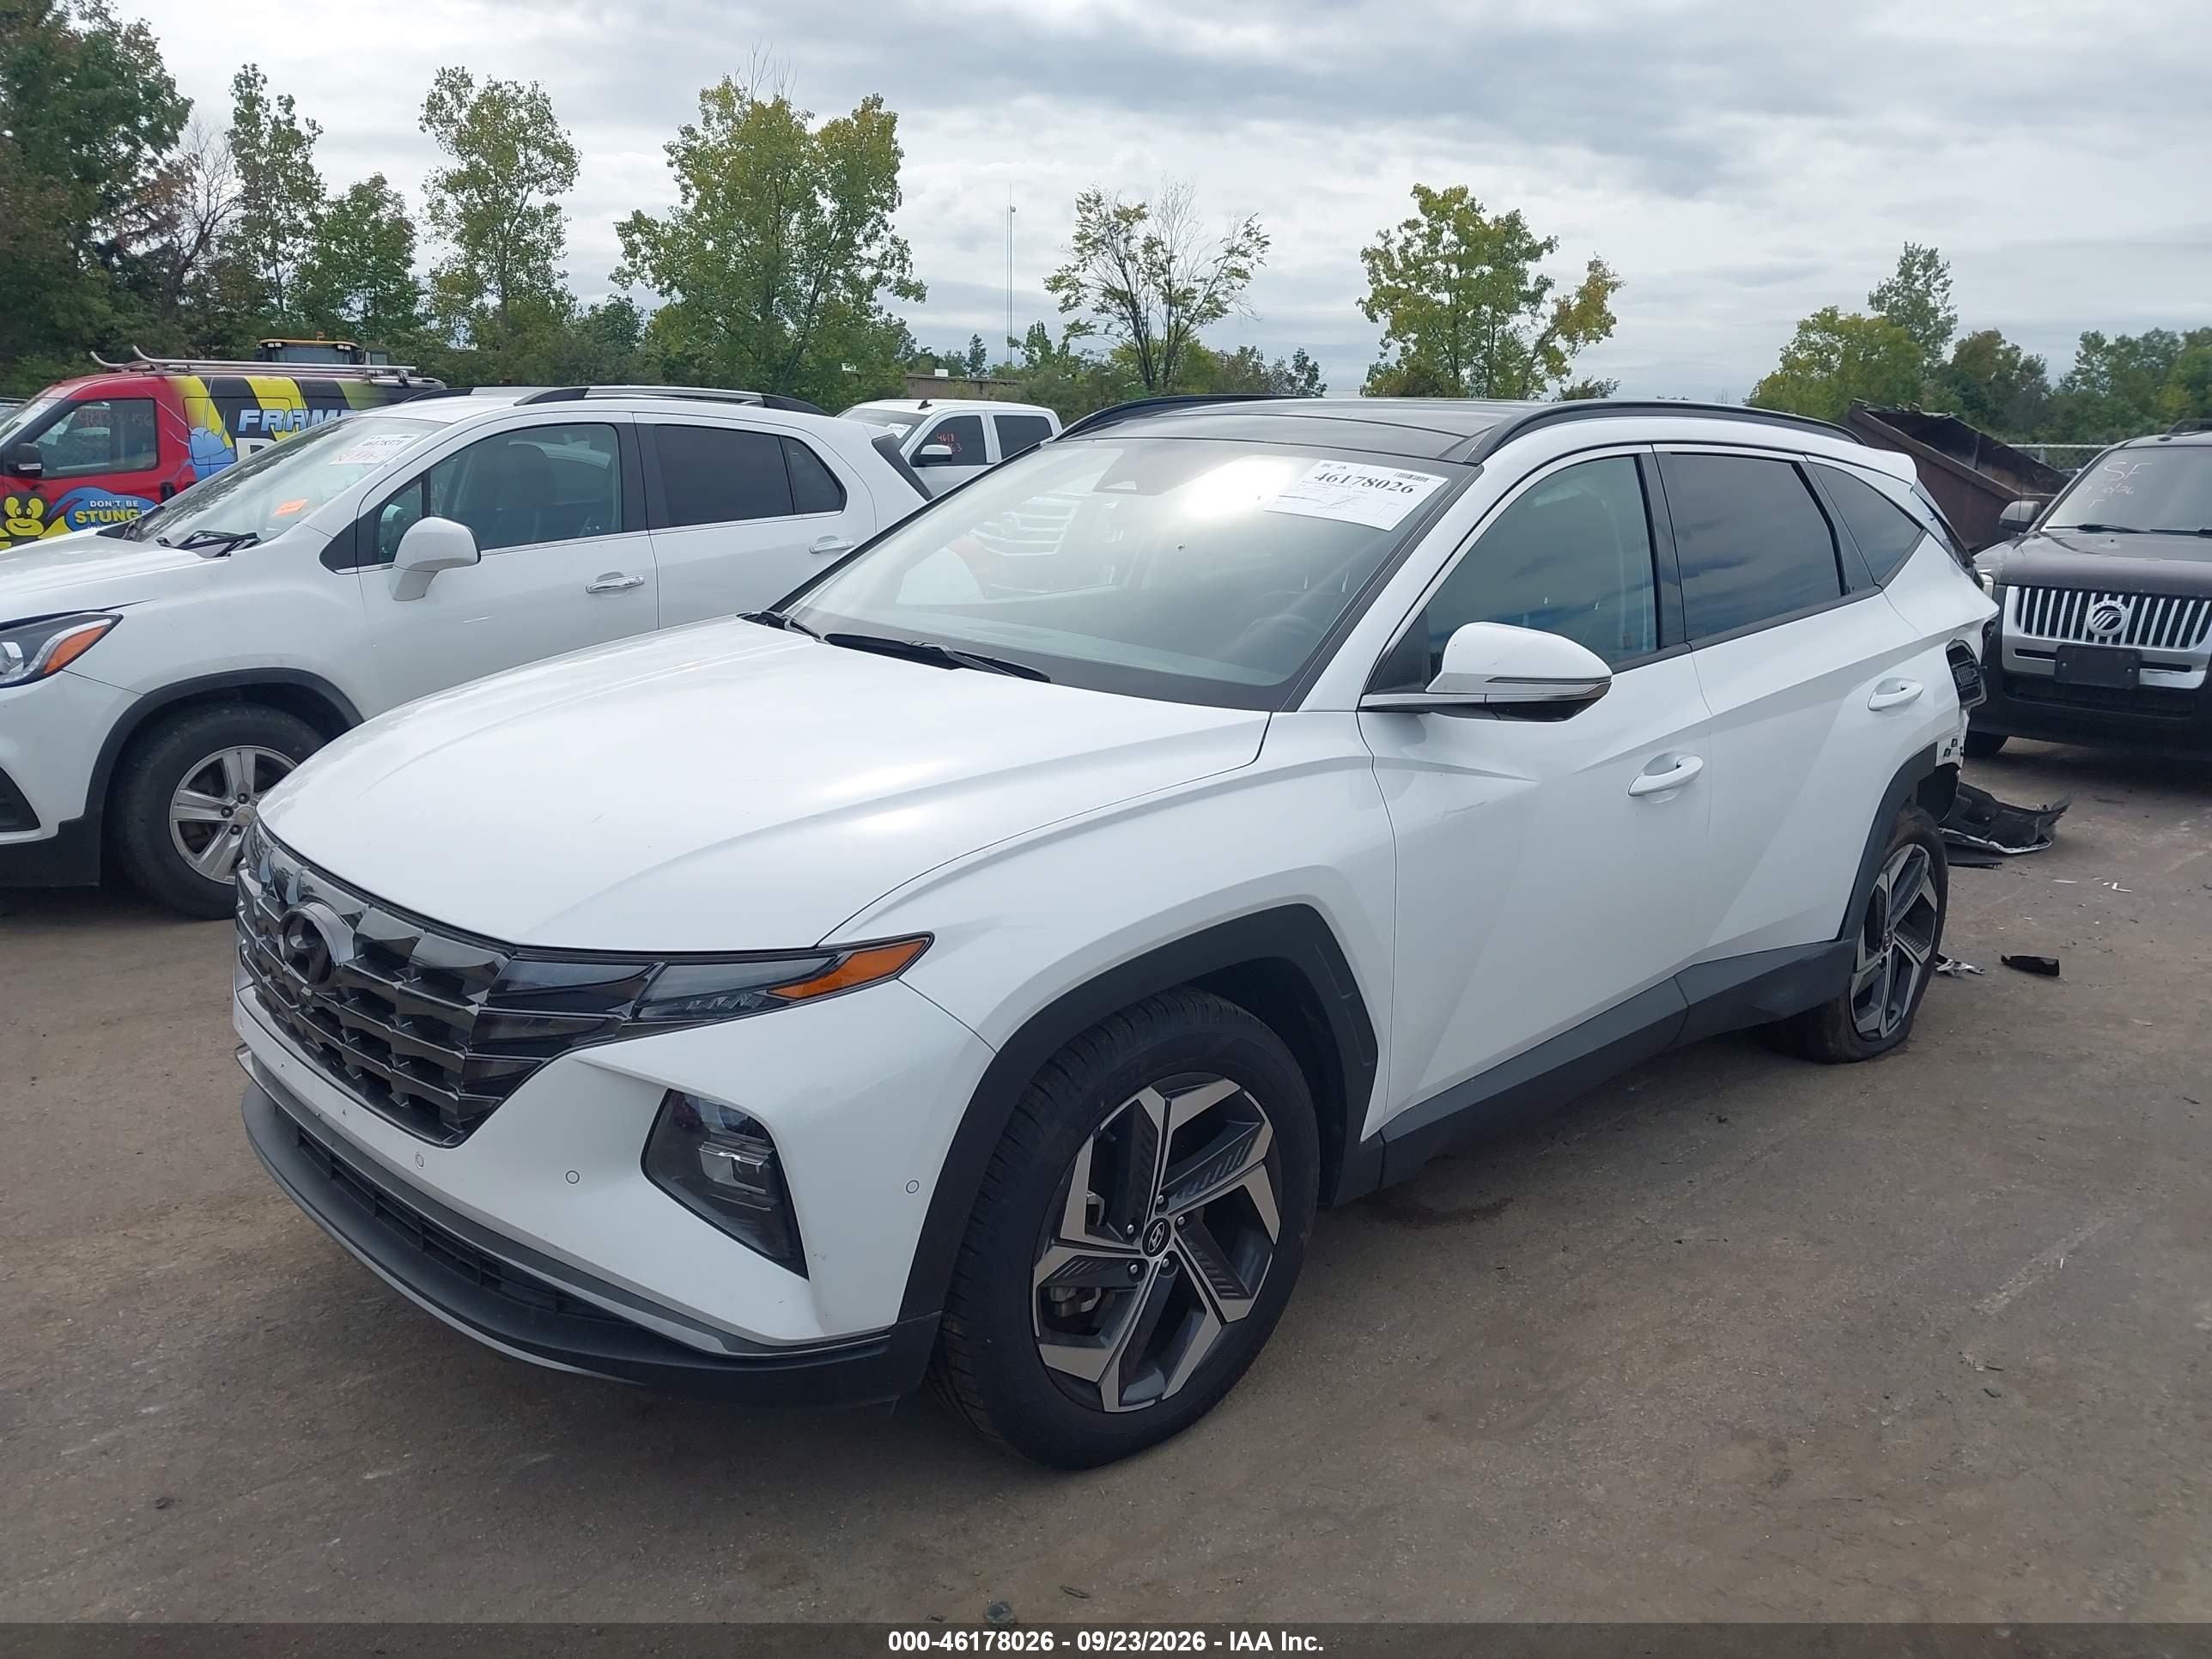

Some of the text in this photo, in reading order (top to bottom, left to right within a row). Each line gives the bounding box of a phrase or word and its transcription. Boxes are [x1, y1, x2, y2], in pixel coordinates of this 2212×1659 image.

[238, 408, 361, 432] FRAM
[1313, 472, 1419, 494] 46178026
[74, 508, 139, 525] STUNG
